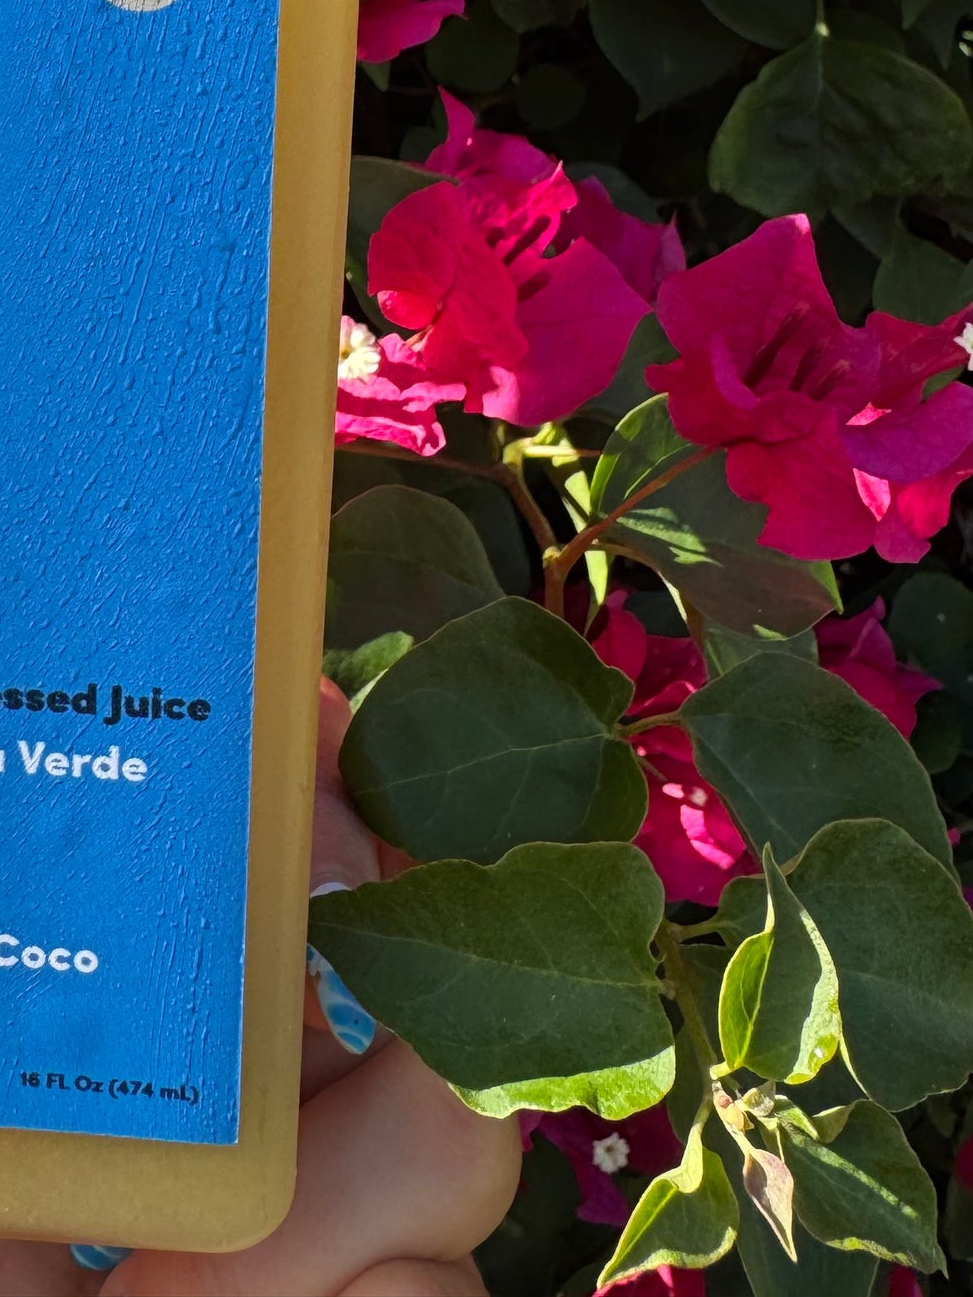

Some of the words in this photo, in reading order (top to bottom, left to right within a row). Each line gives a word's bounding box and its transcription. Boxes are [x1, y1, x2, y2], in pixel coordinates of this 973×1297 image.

[103, 683, 211, 725] Juice
[17, 739, 148, 782] Verde
[20, 1072, 41, 1088] 16
[74, 1076, 105, 1094] Oz
[108, 1079, 154, 1099] (474
